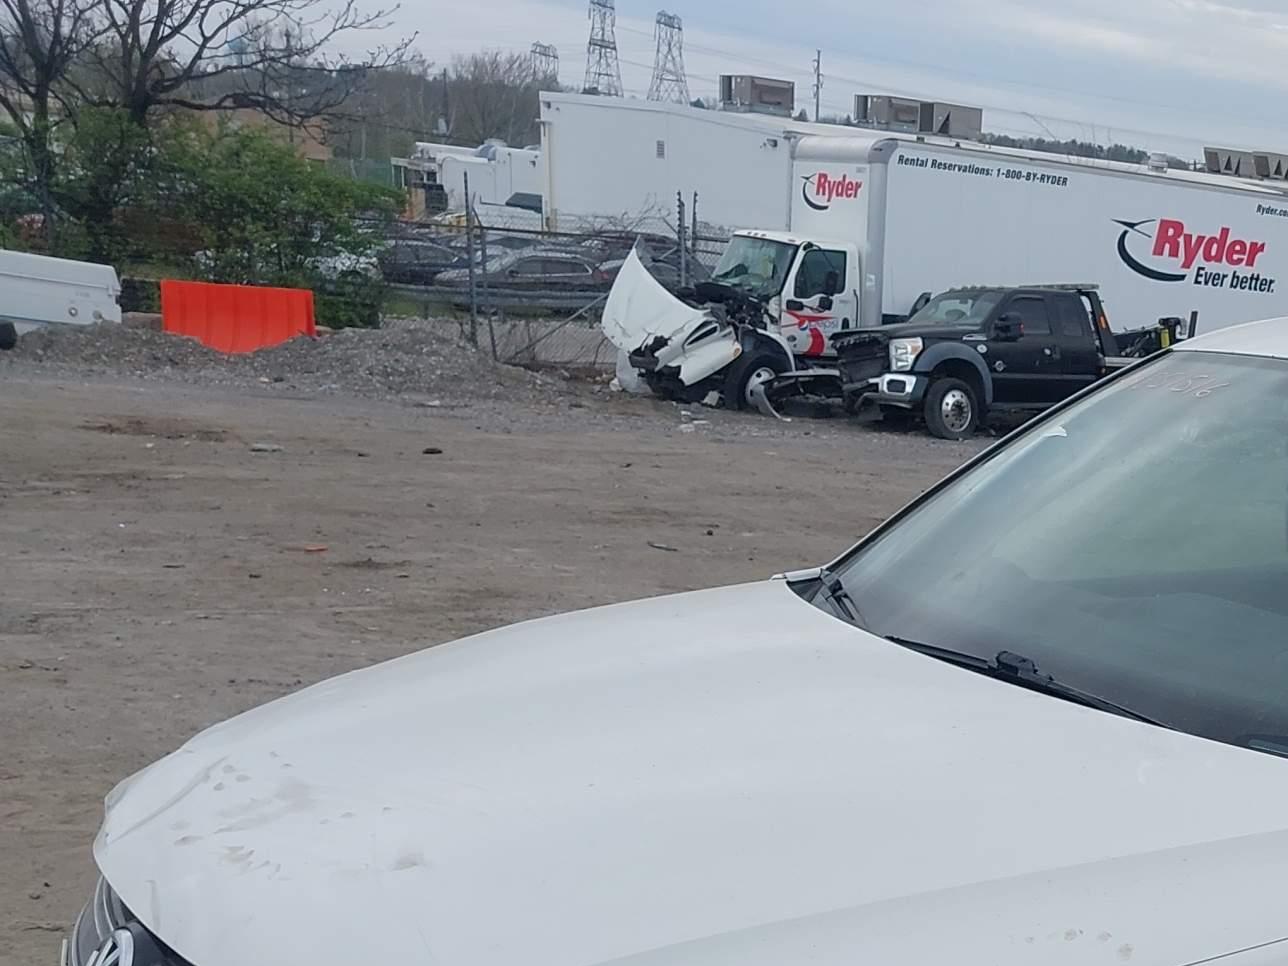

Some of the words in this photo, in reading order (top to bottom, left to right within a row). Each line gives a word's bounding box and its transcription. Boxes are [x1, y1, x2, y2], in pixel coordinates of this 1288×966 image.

[897, 154, 928, 168] Rental
[930, 158, 993, 177] Reservations:
[996, 167, 1069, 187] 1-800-BY-RYDER
[815, 172, 863, 203] Ryder
[1152, 218, 1266, 270] Ryder
[1193, 266, 1229, 287] Ever
[1229, 270, 1276, 294] better.
